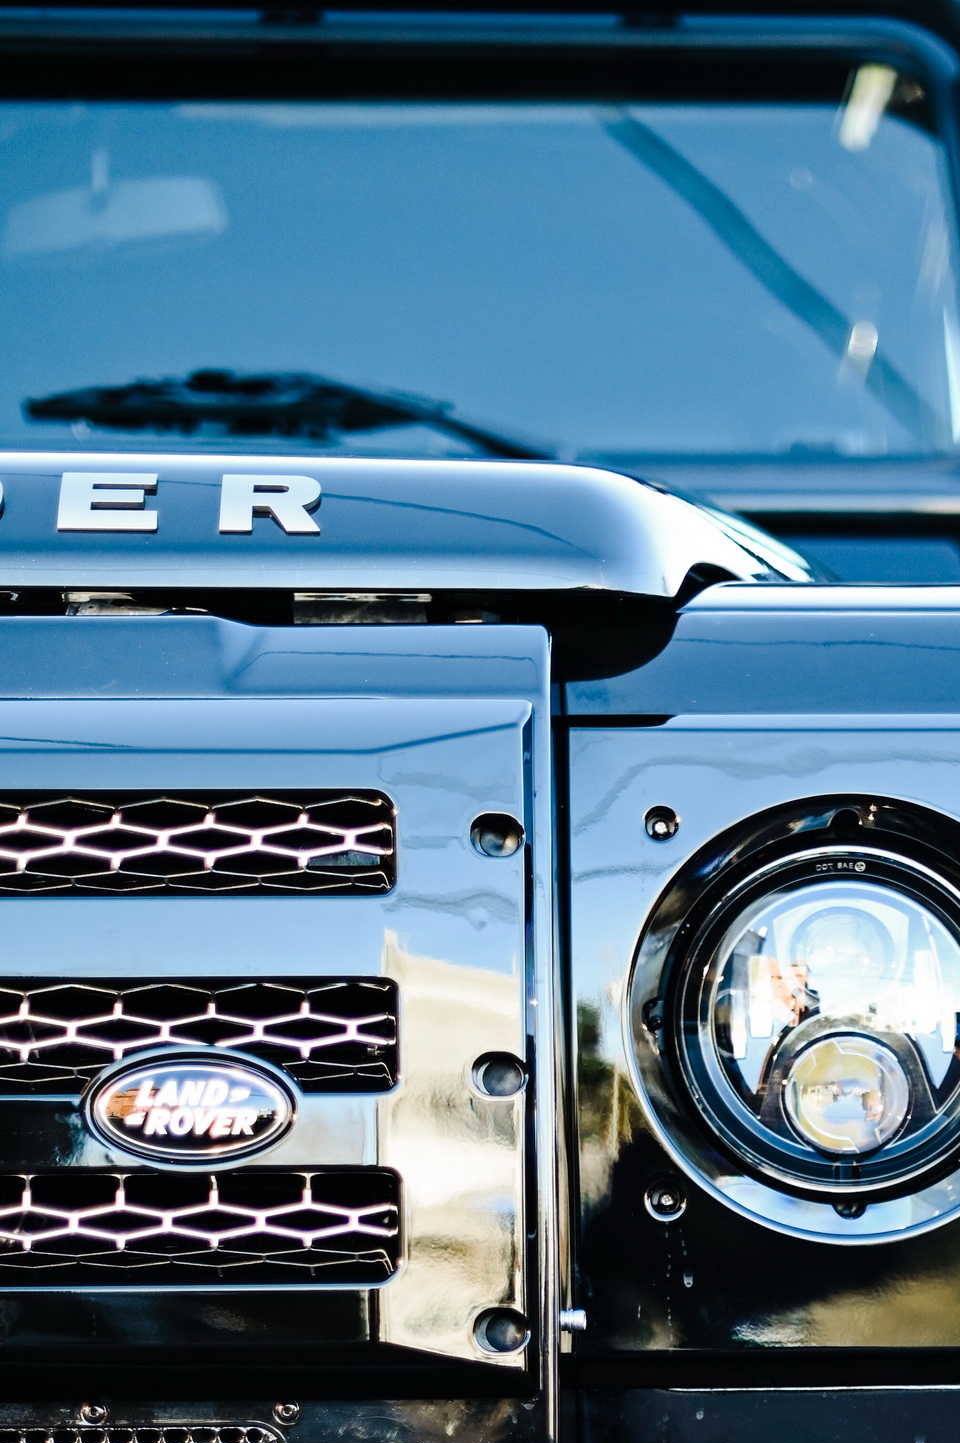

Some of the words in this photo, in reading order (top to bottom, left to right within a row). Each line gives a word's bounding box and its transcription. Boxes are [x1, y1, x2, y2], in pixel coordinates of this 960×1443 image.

[0, 472, 322, 535] ER
[815, 863, 833, 871] DOT
[136, 1080, 229, 1106] LAND
[144, 1108, 257, 1136] ROVER
